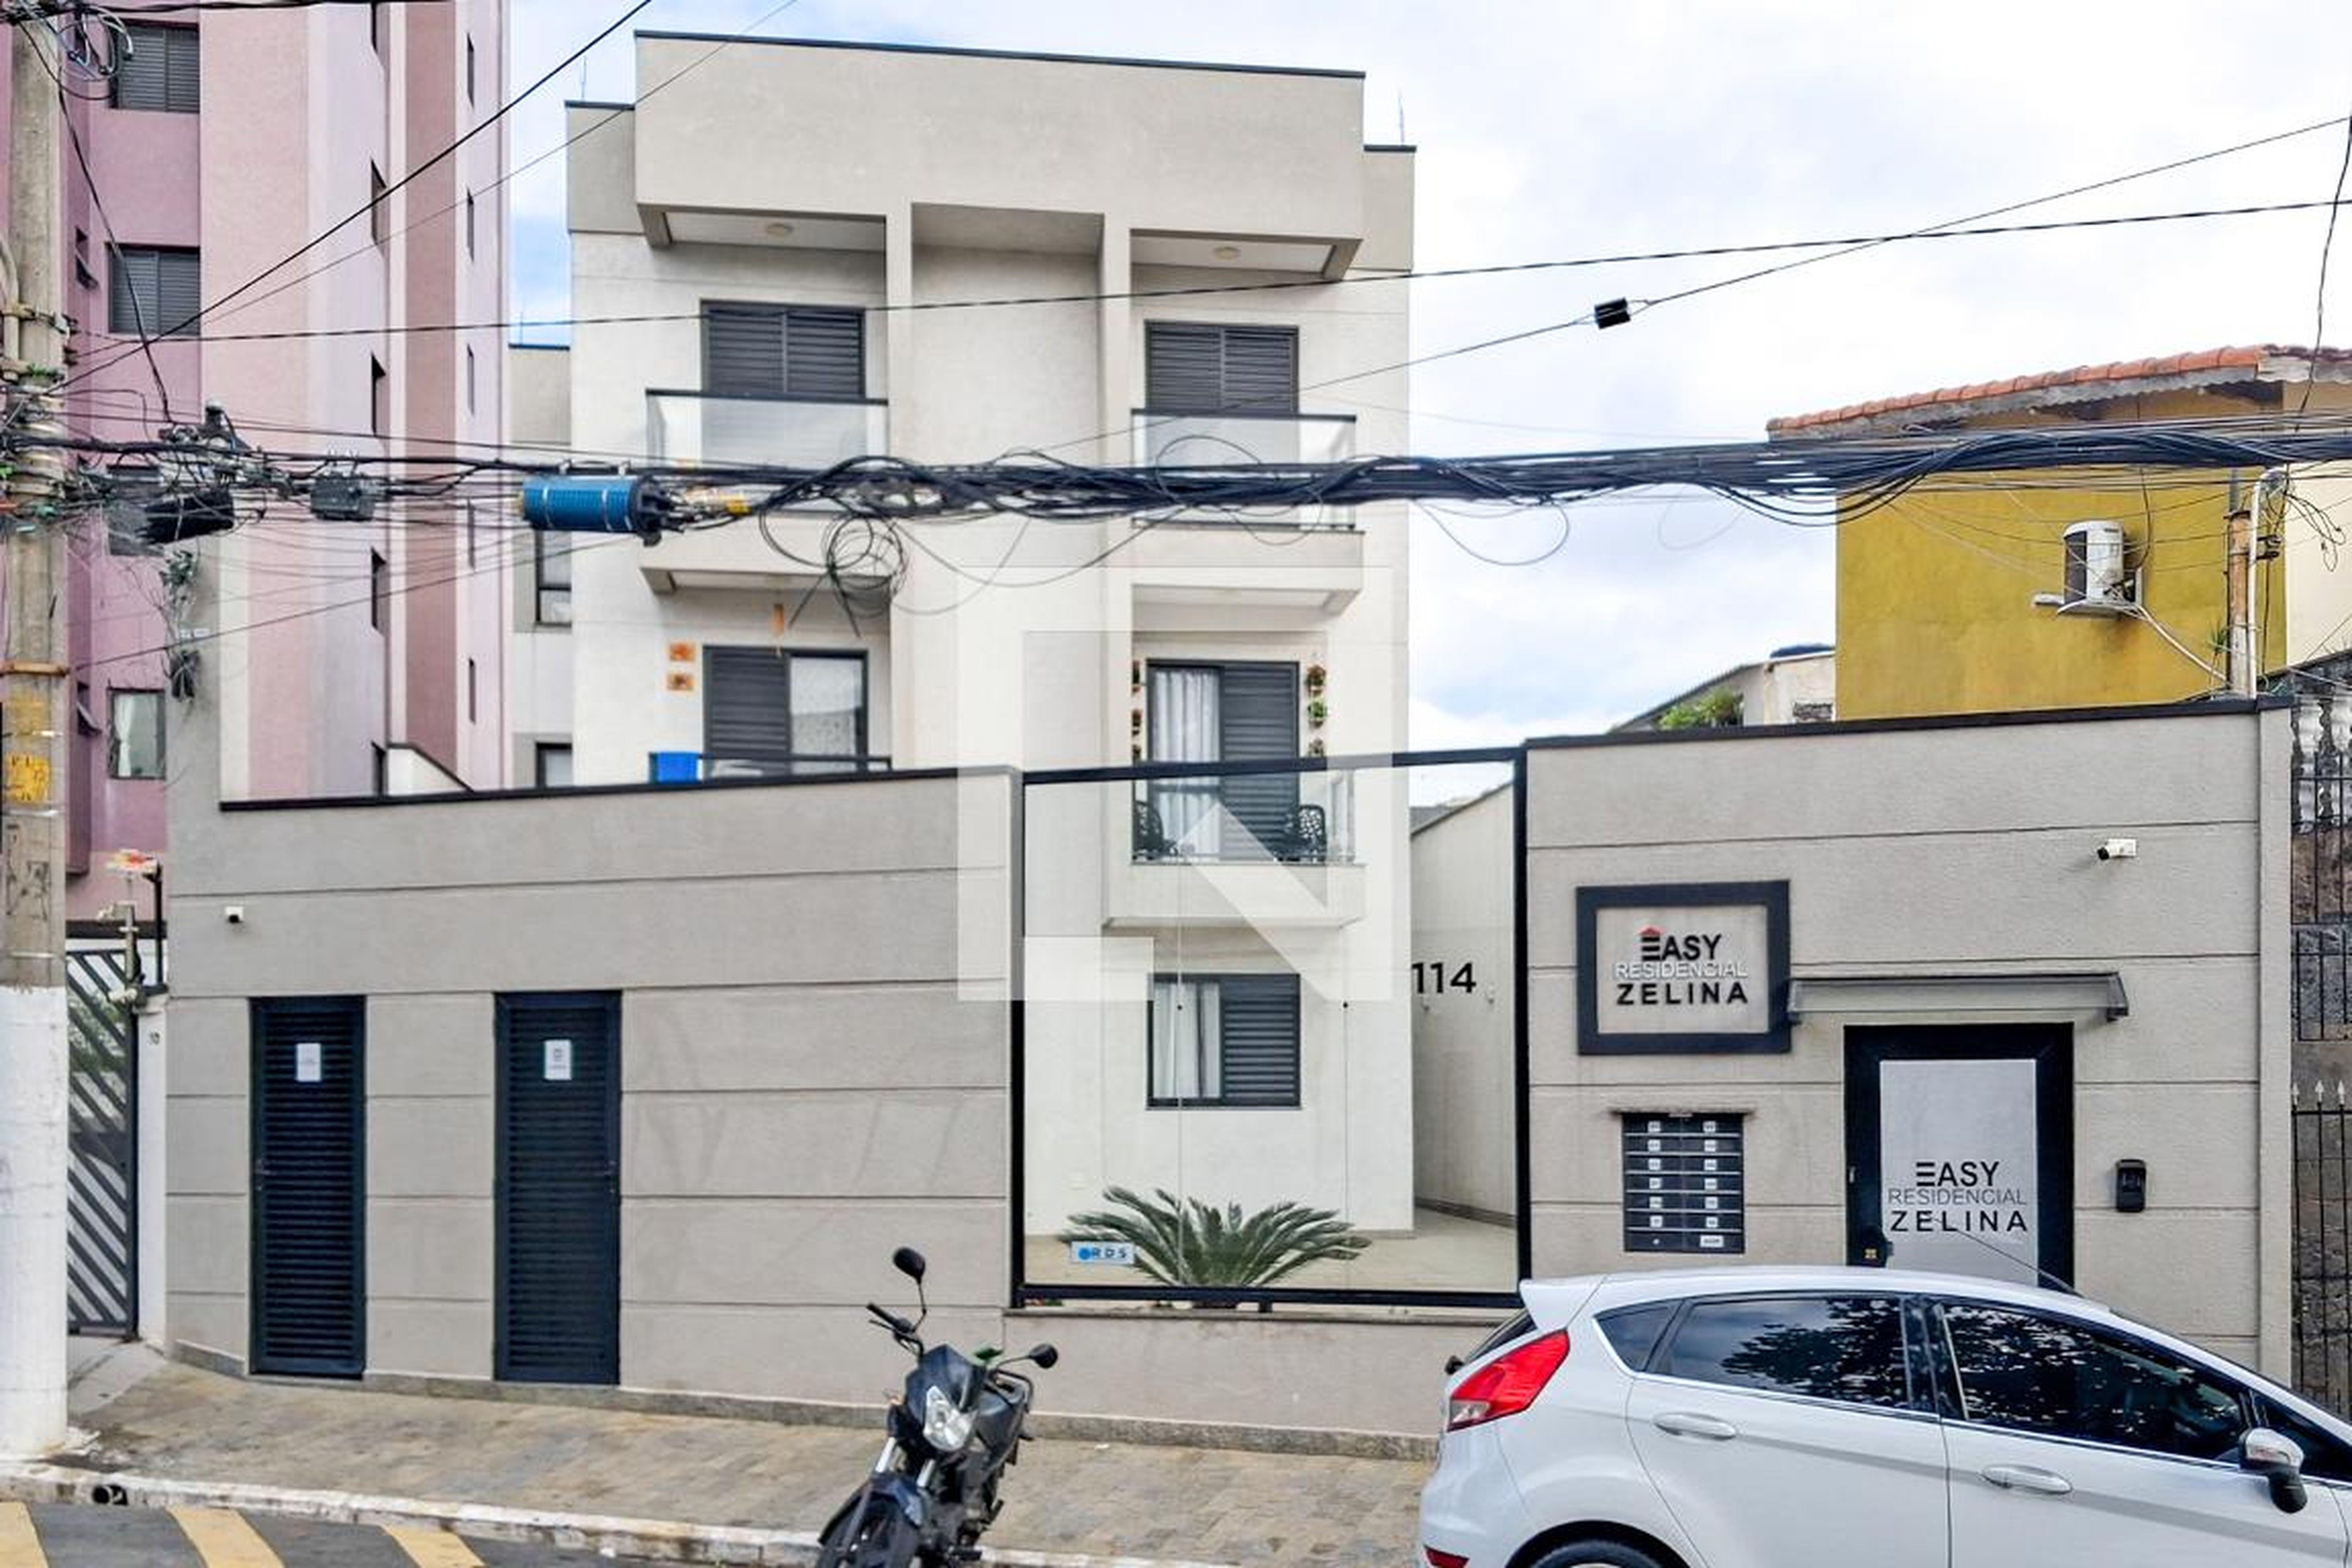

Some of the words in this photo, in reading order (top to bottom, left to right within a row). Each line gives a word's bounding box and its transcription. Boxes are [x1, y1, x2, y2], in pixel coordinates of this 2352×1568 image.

[1641, 934, 1722, 962] EASY
[1411, 962, 1477, 994] 114
[1615, 962, 1748, 979] RESIDENCIAL
[1616, 982, 1748, 1006] ZELINA
[1915, 1161, 2000, 1187] EASY
[1887, 1188, 2027, 1205] RESIDENCIAL
[1890, 1210, 2028, 1232] ZELINA
